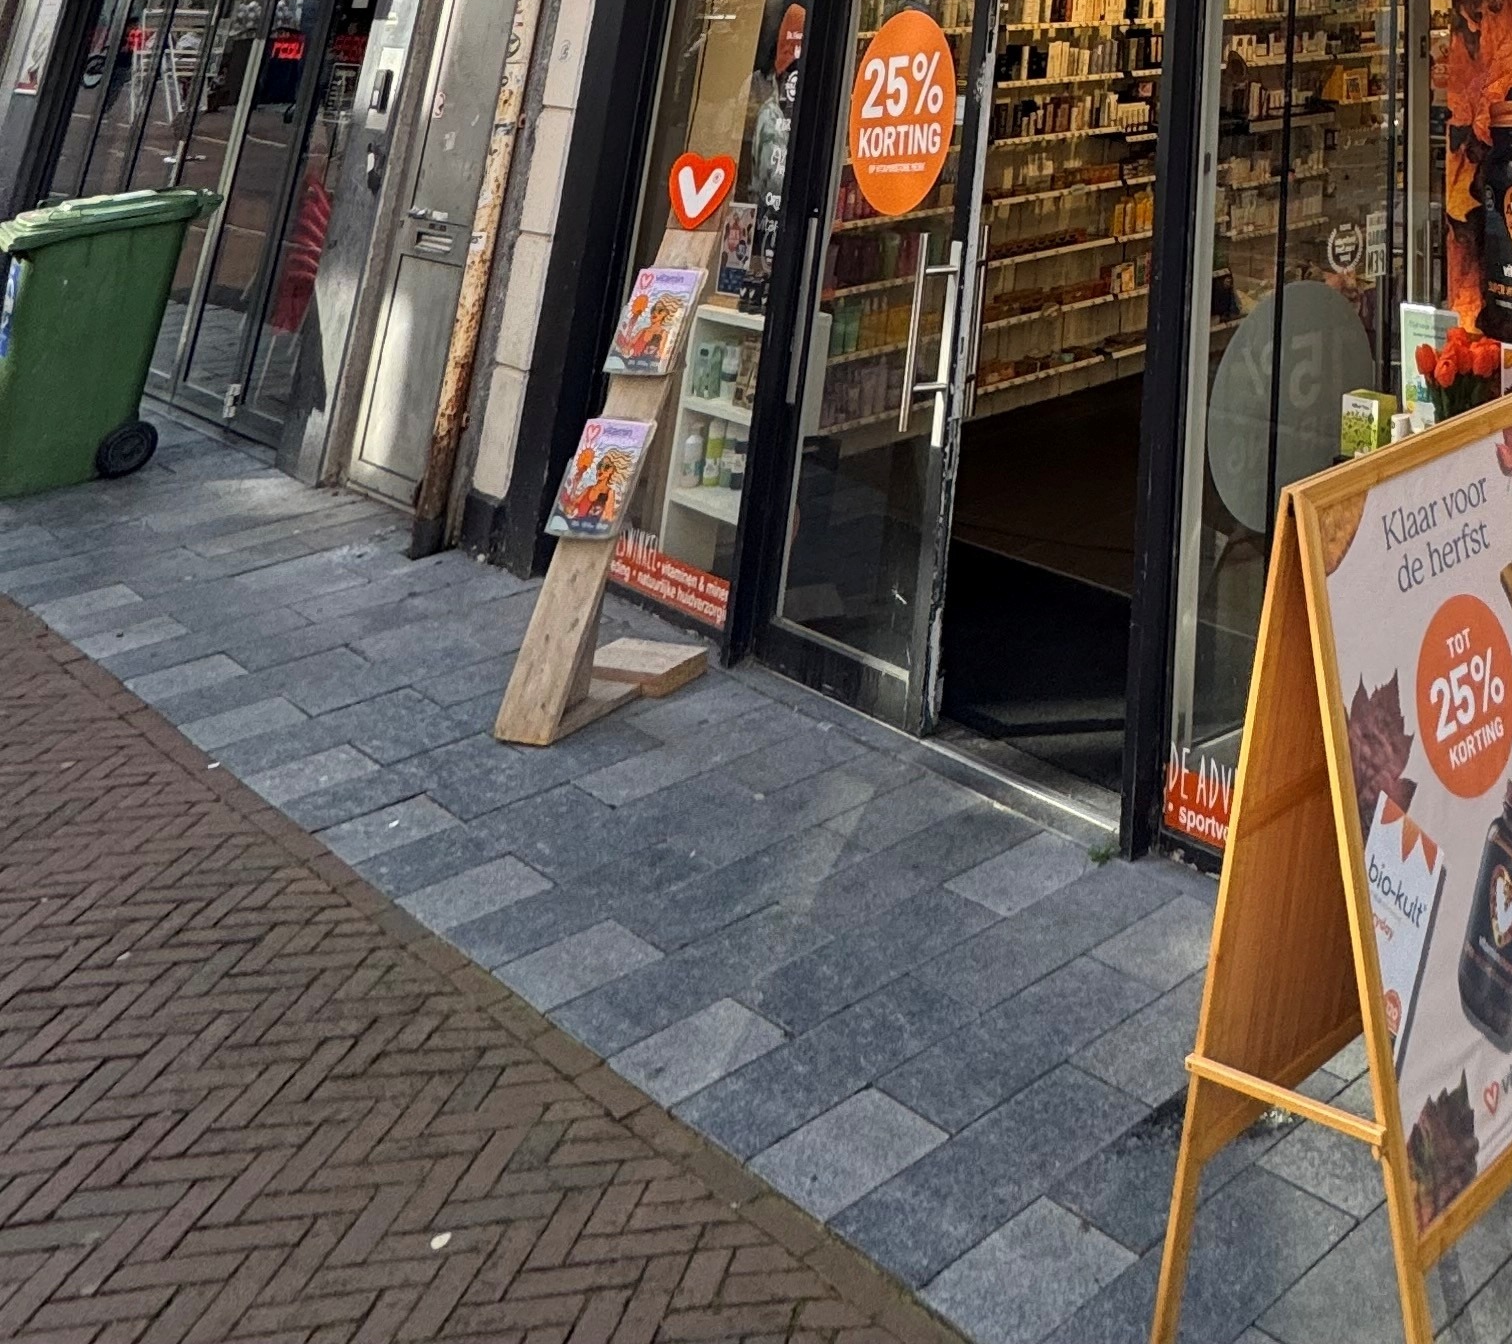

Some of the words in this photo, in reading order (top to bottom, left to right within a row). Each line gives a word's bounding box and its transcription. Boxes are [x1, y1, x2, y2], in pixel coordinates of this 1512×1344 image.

[861, 52, 944, 119] 25%
[857, 122, 941, 159] KORTING
[1382, 500, 1437, 550] Klaar
[1442, 477, 1487, 520] voor
[1397, 553, 1425, 593] de
[1426, 521, 1490, 577] herfst
[1446, 628, 1470, 658] TOT
[1430, 647, 1505, 743] 25%
[1168, 741, 1190, 800] DE
[1196, 754, 1238, 815] ADV
[1449, 716, 1505, 771] KORTING
[1369, 853, 1423, 929] bio-kult
